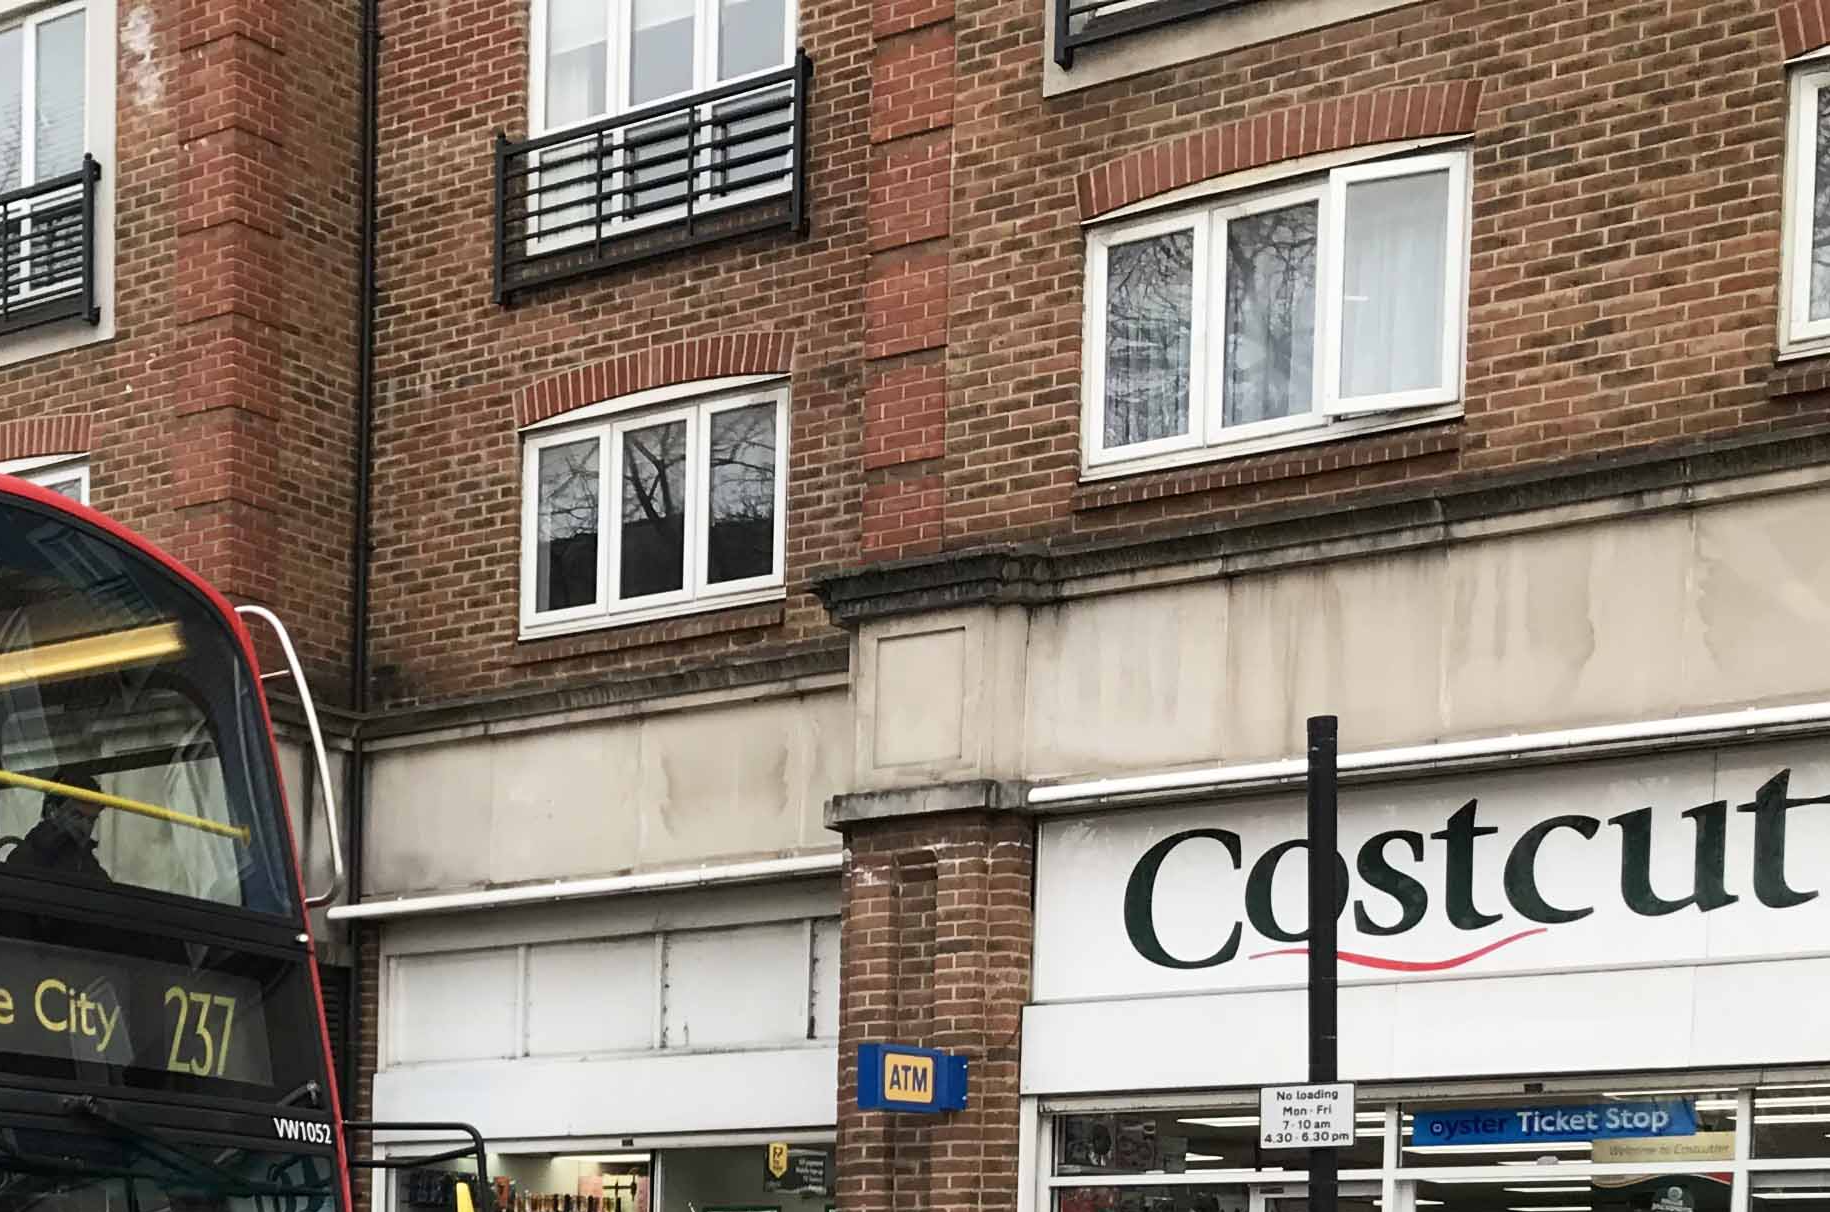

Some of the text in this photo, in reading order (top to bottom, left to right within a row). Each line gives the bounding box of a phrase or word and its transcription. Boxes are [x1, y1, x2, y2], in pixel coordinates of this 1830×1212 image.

[1123, 768, 1830, 969] Costcut
[33, 976, 120, 1052] City
[164, 985, 236, 1076] 237
[890, 1064, 928, 1093] ATM
[1276, 1089, 1338, 1101] No loading
[1283, 1106, 1307, 1116] Mon
[1316, 1104, 1332, 1115] Fri
[274, 1116, 333, 1146] VW1052
[1429, 1107, 1669, 1140] oyster Ticket Stop
